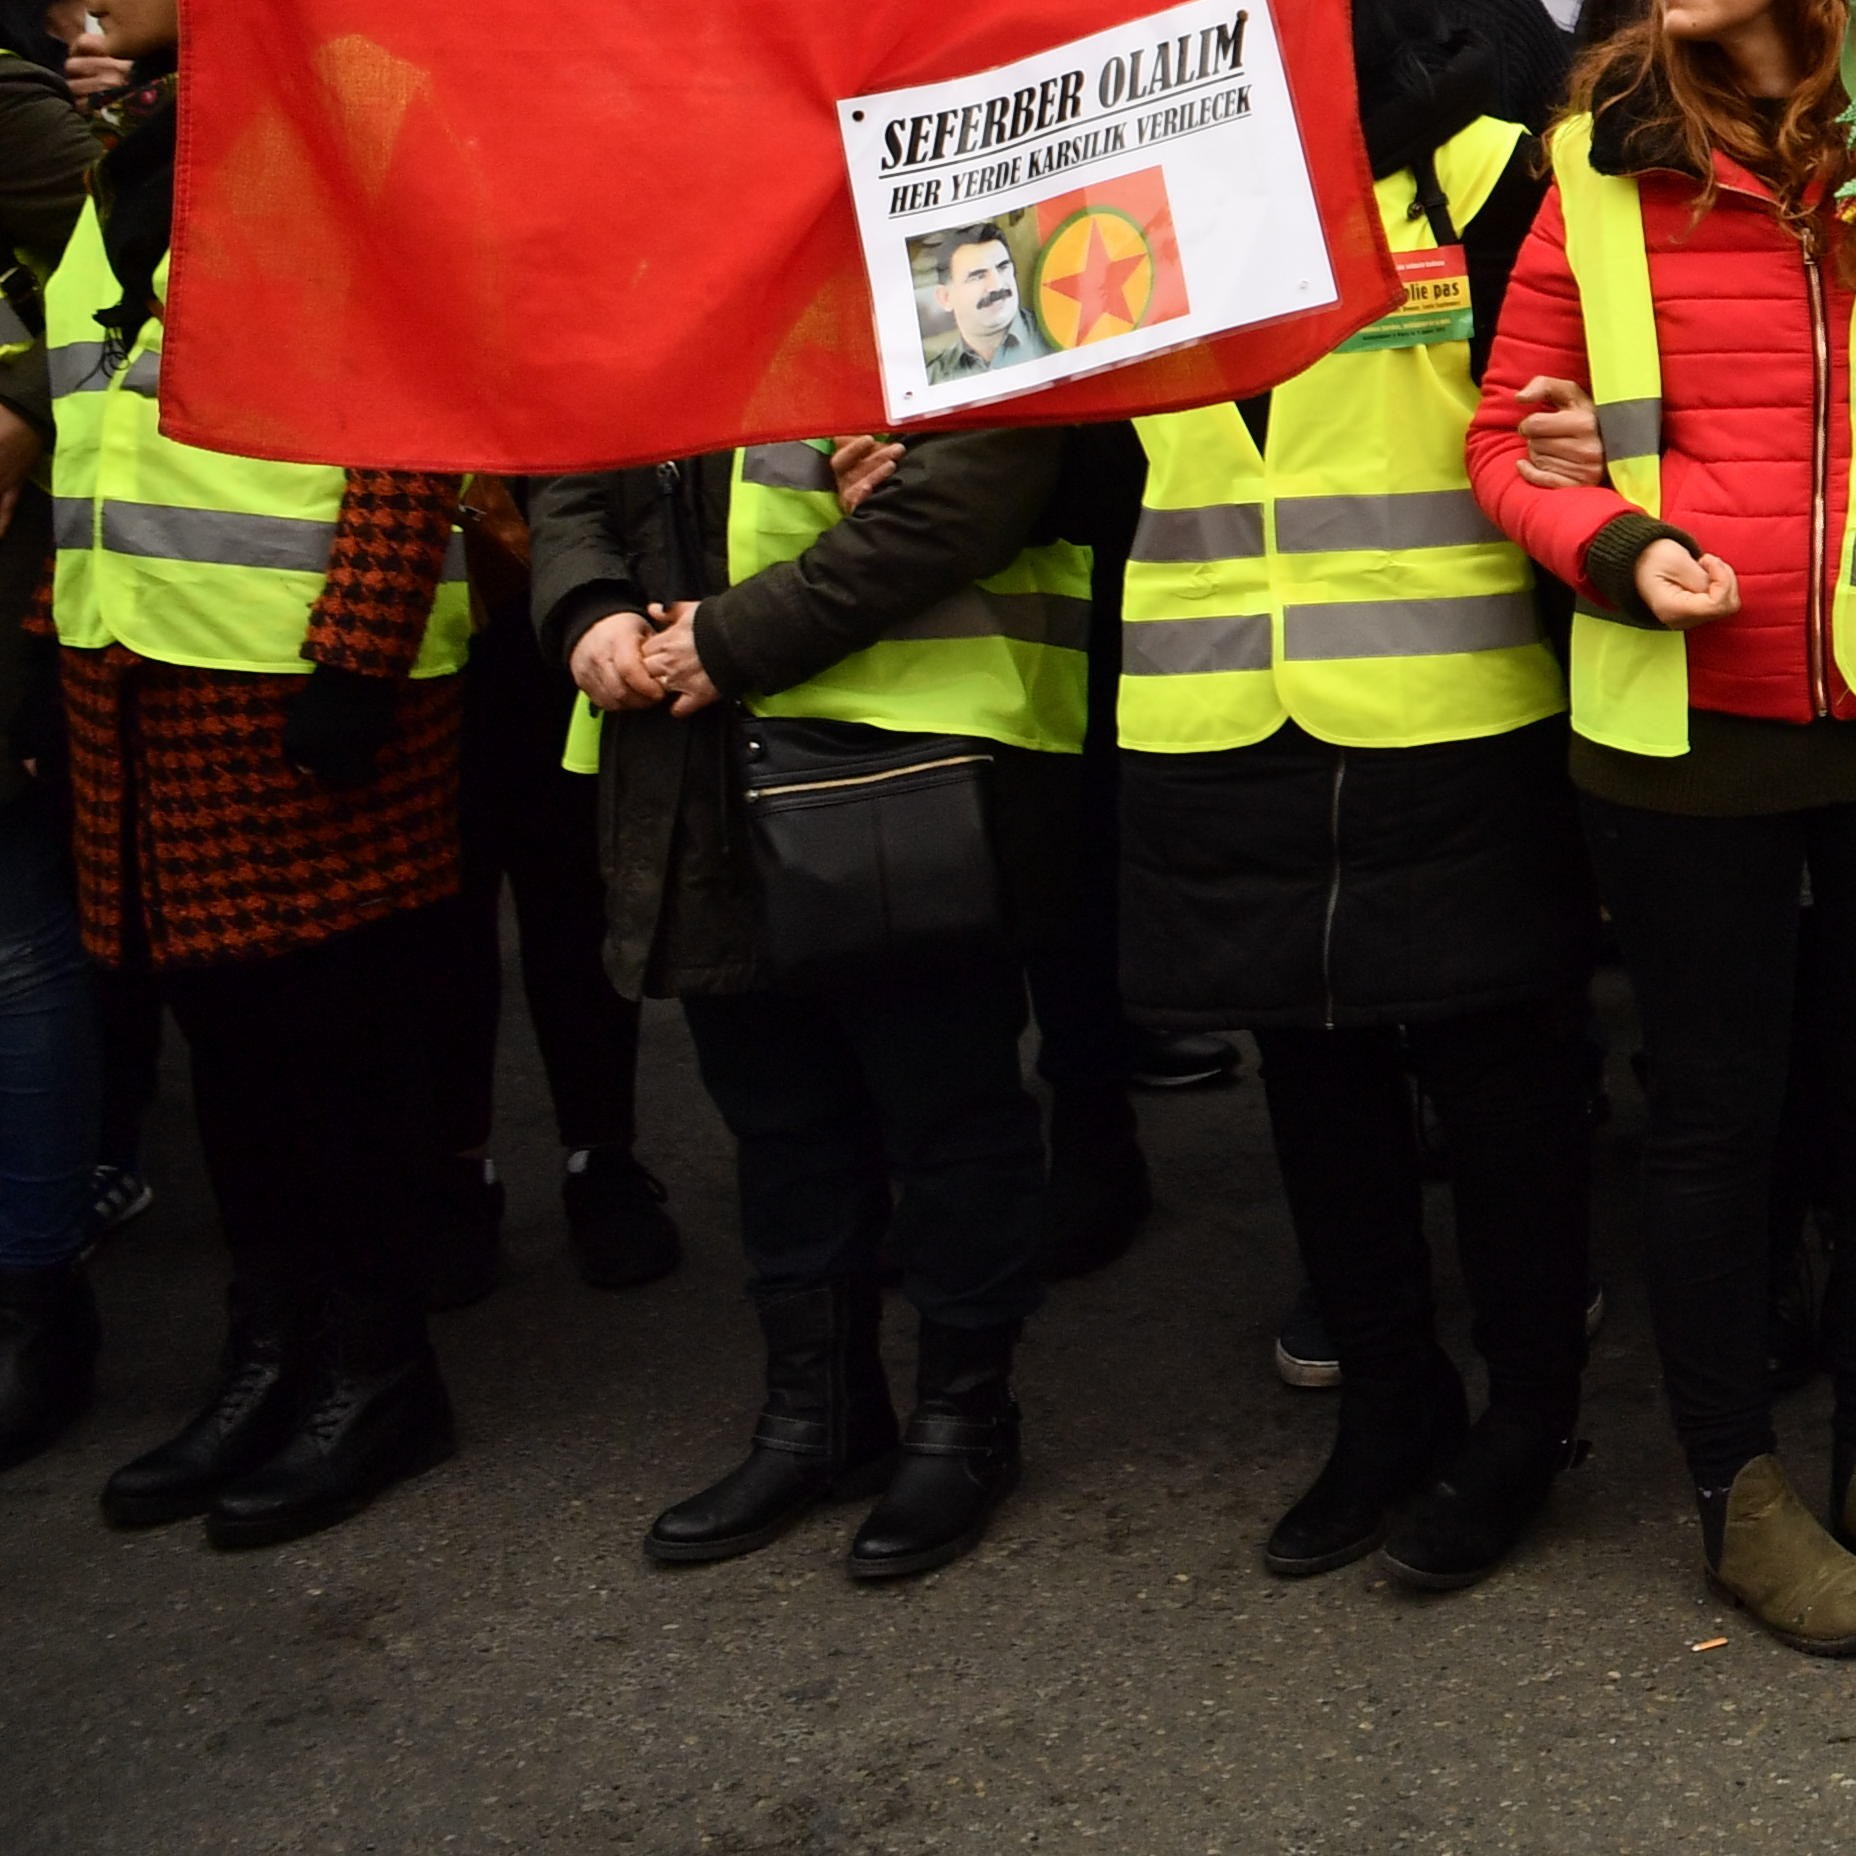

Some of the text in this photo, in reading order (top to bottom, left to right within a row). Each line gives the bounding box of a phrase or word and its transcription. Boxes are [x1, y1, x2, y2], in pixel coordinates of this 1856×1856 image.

[881, 20, 1247, 172] SEFERBER OLALIM
[889, 84, 1253, 216] HER YERDE KARSILIK VERILECEK
